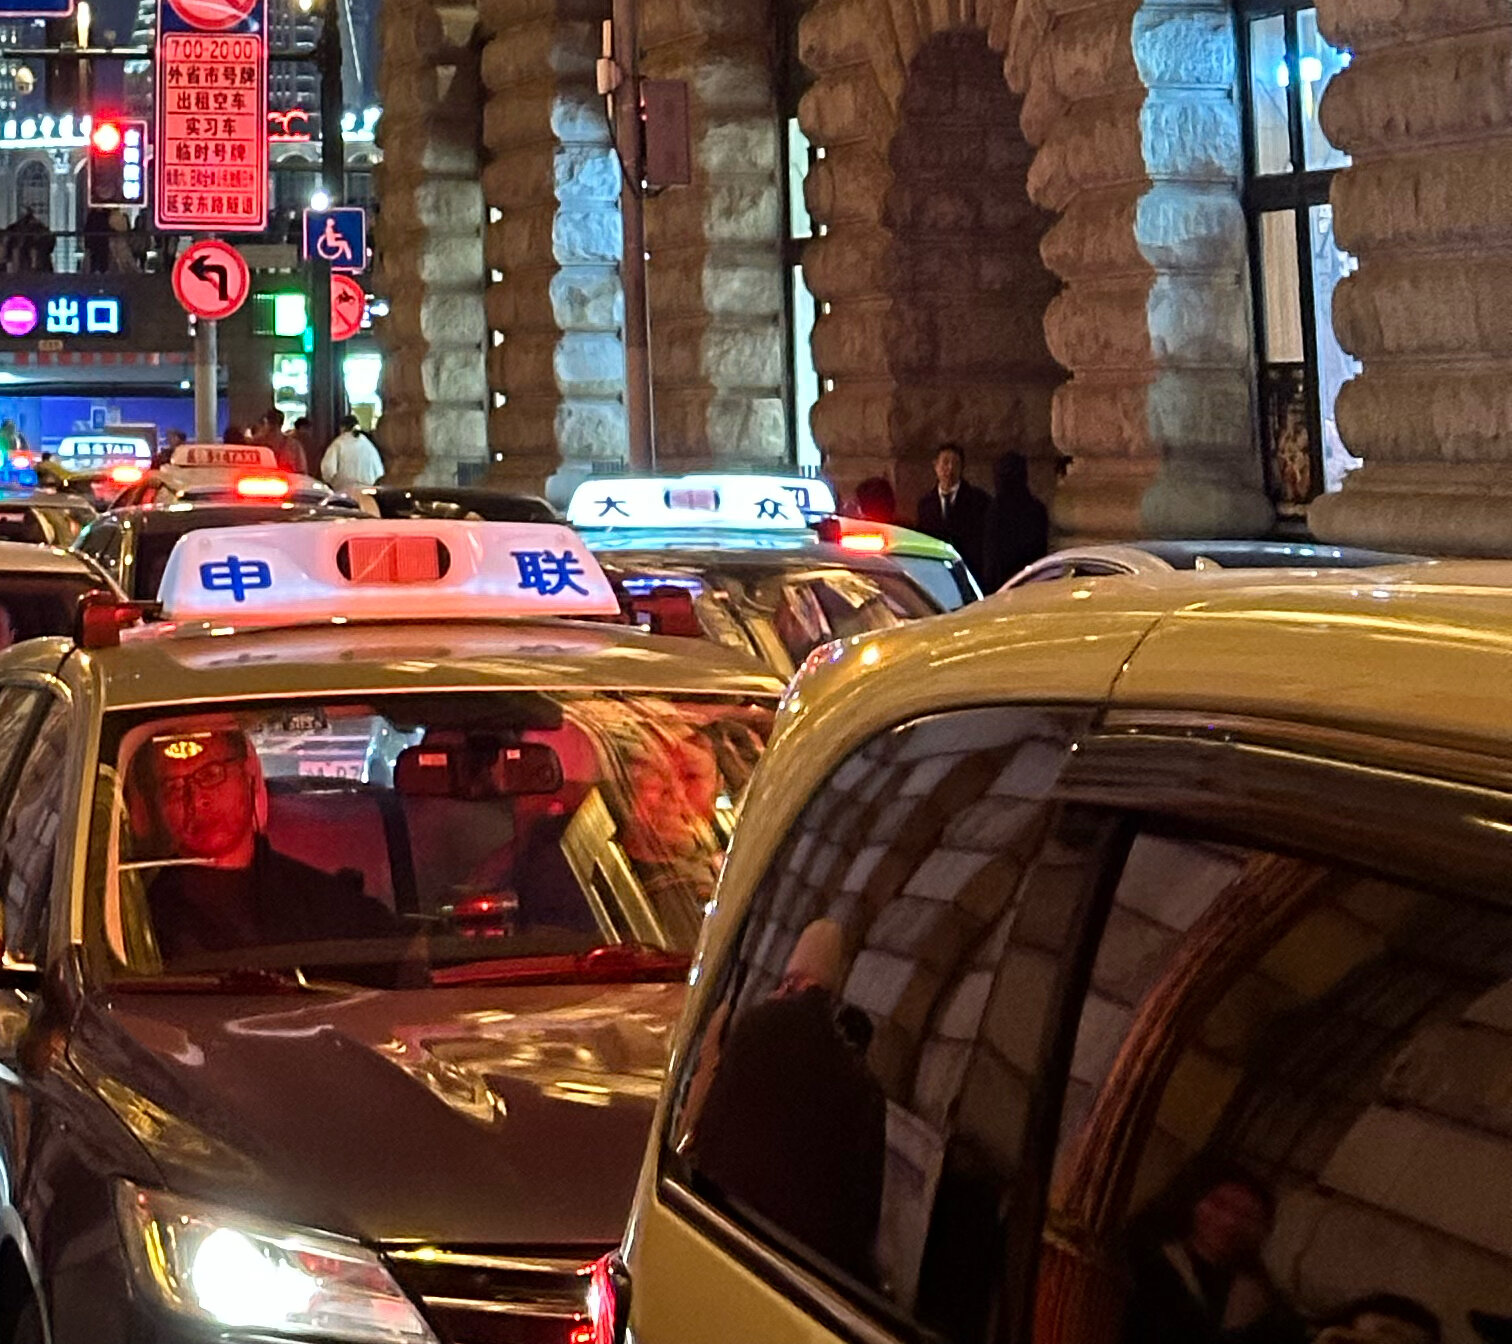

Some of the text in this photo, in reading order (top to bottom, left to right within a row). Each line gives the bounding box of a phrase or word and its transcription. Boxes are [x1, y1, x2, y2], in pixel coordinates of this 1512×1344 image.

[167, 64, 255, 85] 外省市号牌
[176, 90, 246, 110] 出租空车
[185, 117, 237, 137] 实习车
[175, 141, 247, 162] 临时号牌
[167, 194, 253, 215] 延安东路隧道
[46, 297, 119, 334] 出口
[593, 496, 631, 518] 大
[753, 497, 790, 520] 众
[199, 549, 589, 603] 申 联
